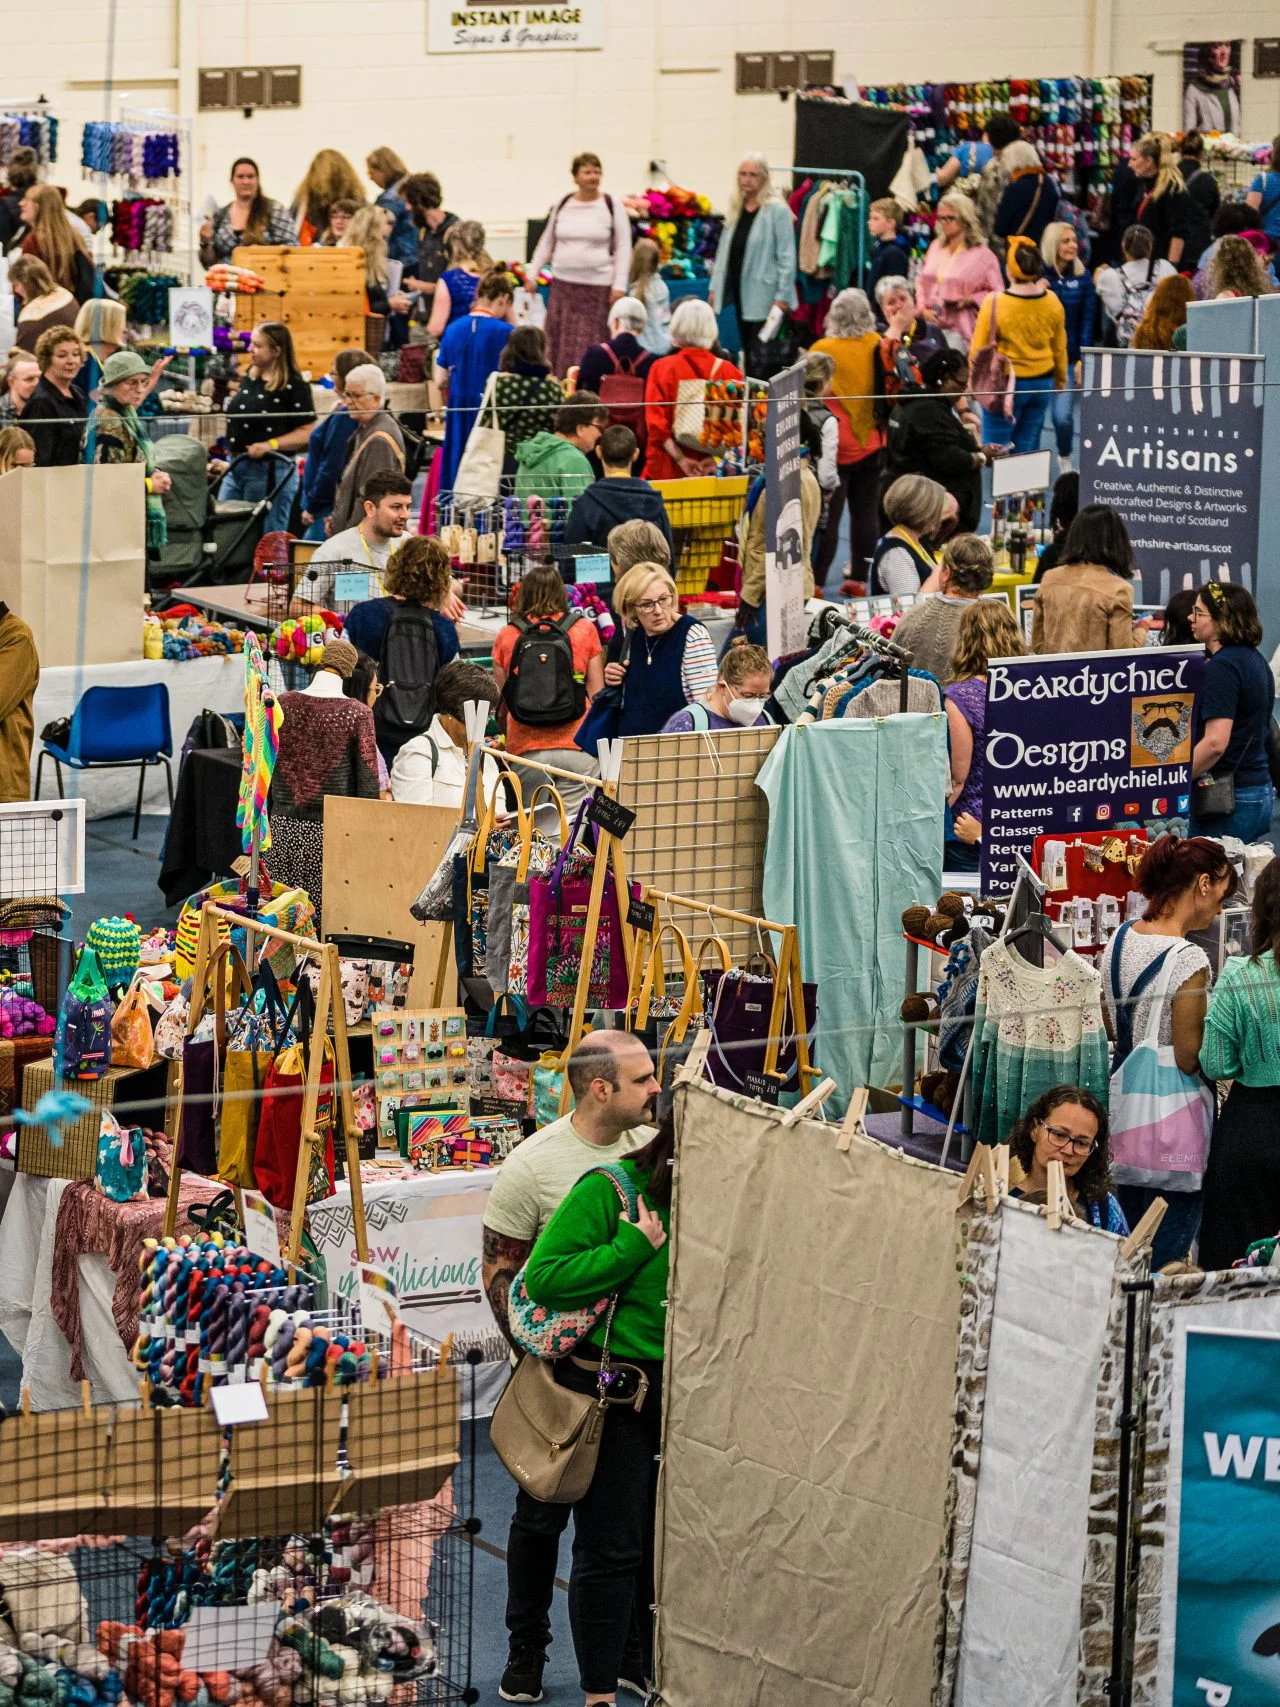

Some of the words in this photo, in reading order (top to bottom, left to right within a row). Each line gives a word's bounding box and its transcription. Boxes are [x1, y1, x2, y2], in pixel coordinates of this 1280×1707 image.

[452, 11, 520, 26] INSTANT
[526, 9, 581, 24] IMAGE
[453, 29, 495, 45] Signs
[516, 28, 578, 46] Graphics
[1097, 423, 1239, 439] PERTHSHIRE
[1097, 436, 1238, 473] Artisans
[1093, 479, 1134, 492] Creative,
[1136, 482, 1182, 494] Authentic
[1184, 485, 1192, 495] &
[1194, 485, 1243, 498] Distinctive
[1094, 495, 1153, 508] Handcrafted
[1155, 498, 1193, 511] Designs
[1194, 501, 1202, 510] &
[1203, 501, 1247, 513] Artworks
[1130, 511, 1146, 521] the
[1148, 513, 1173, 524] heart
[1176, 514, 1185, 524] of
[1188, 515, 1229, 527] Scotland
[1129, 538, 1232, 554] erthshire-artisans.scot
[987, 660, 1188, 705] Beardychiel
[986, 729, 1127, 773] Designs
[994, 766, 1188, 798] www.beardychiel.uk
[990, 807, 1053, 819] Patterns
[989, 825, 1044, 837] Classes
[989, 844, 1032, 855] Retre
[989, 861, 1016, 872] Yar
[749, 1083, 764, 1094] TOTES
